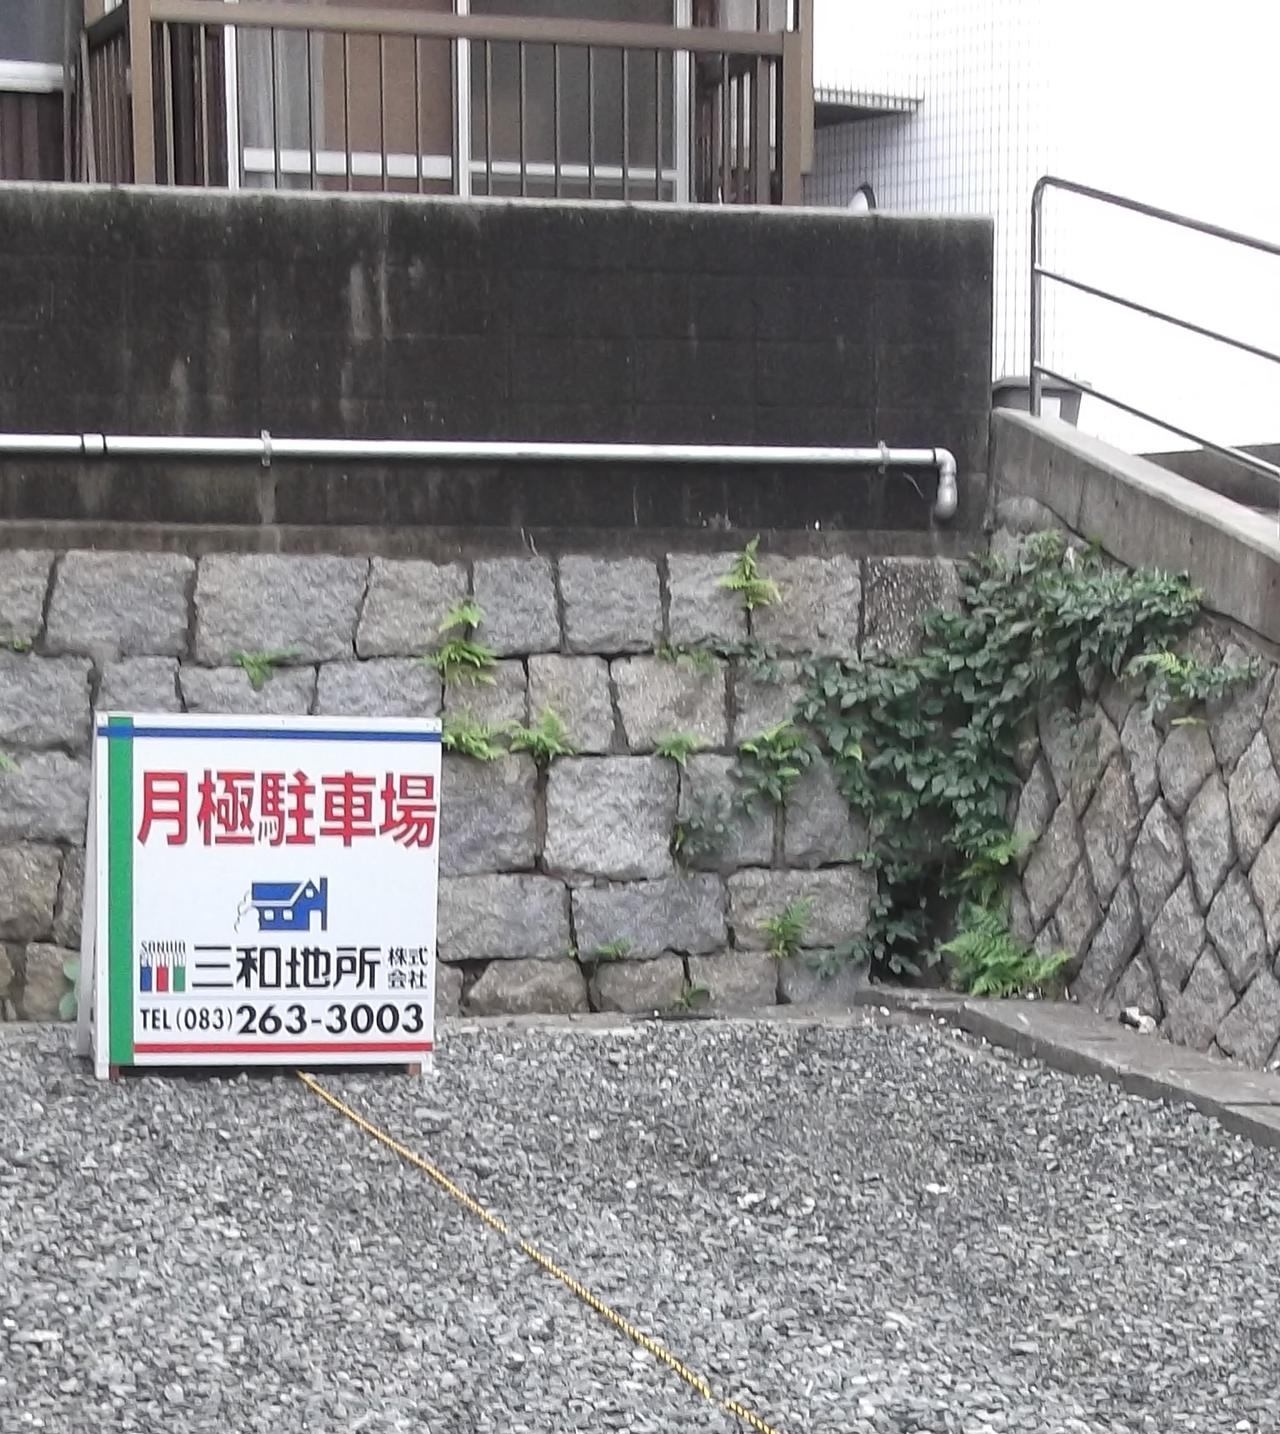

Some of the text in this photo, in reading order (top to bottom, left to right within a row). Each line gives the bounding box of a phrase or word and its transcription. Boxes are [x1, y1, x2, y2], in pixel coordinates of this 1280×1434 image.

[137, 768, 437, 849] 月極駐車場
[192, 945, 381, 989] 三和地所
